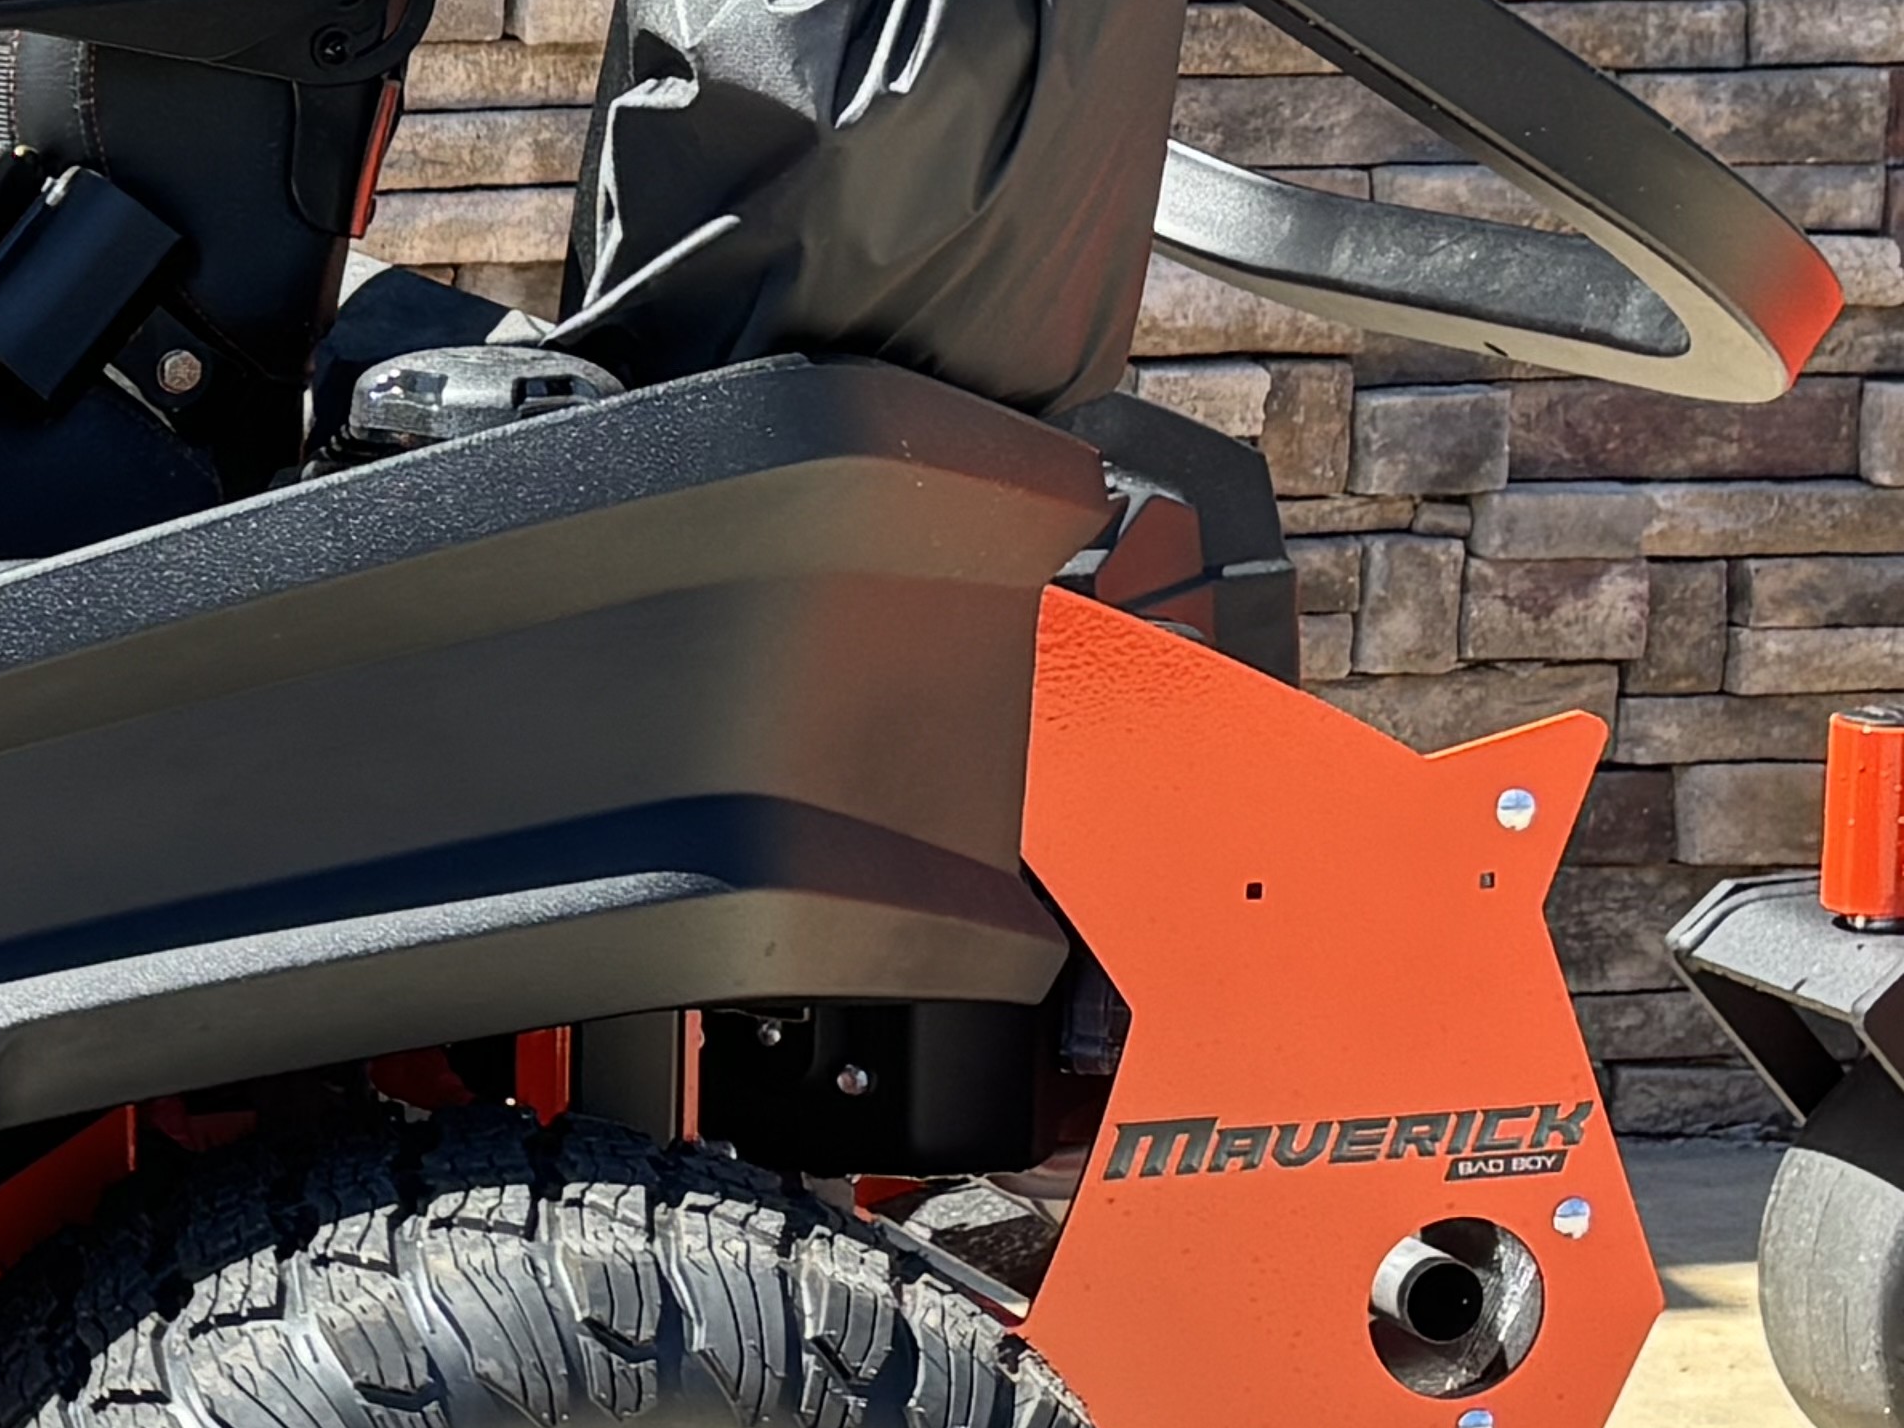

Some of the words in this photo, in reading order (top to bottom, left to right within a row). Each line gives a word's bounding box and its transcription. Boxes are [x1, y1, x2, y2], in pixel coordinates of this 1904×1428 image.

[1103, 1100, 1594, 1181] MAVERICK
[1457, 1158, 1505, 1176] BAD
[1511, 1153, 1558, 1172] BOY
